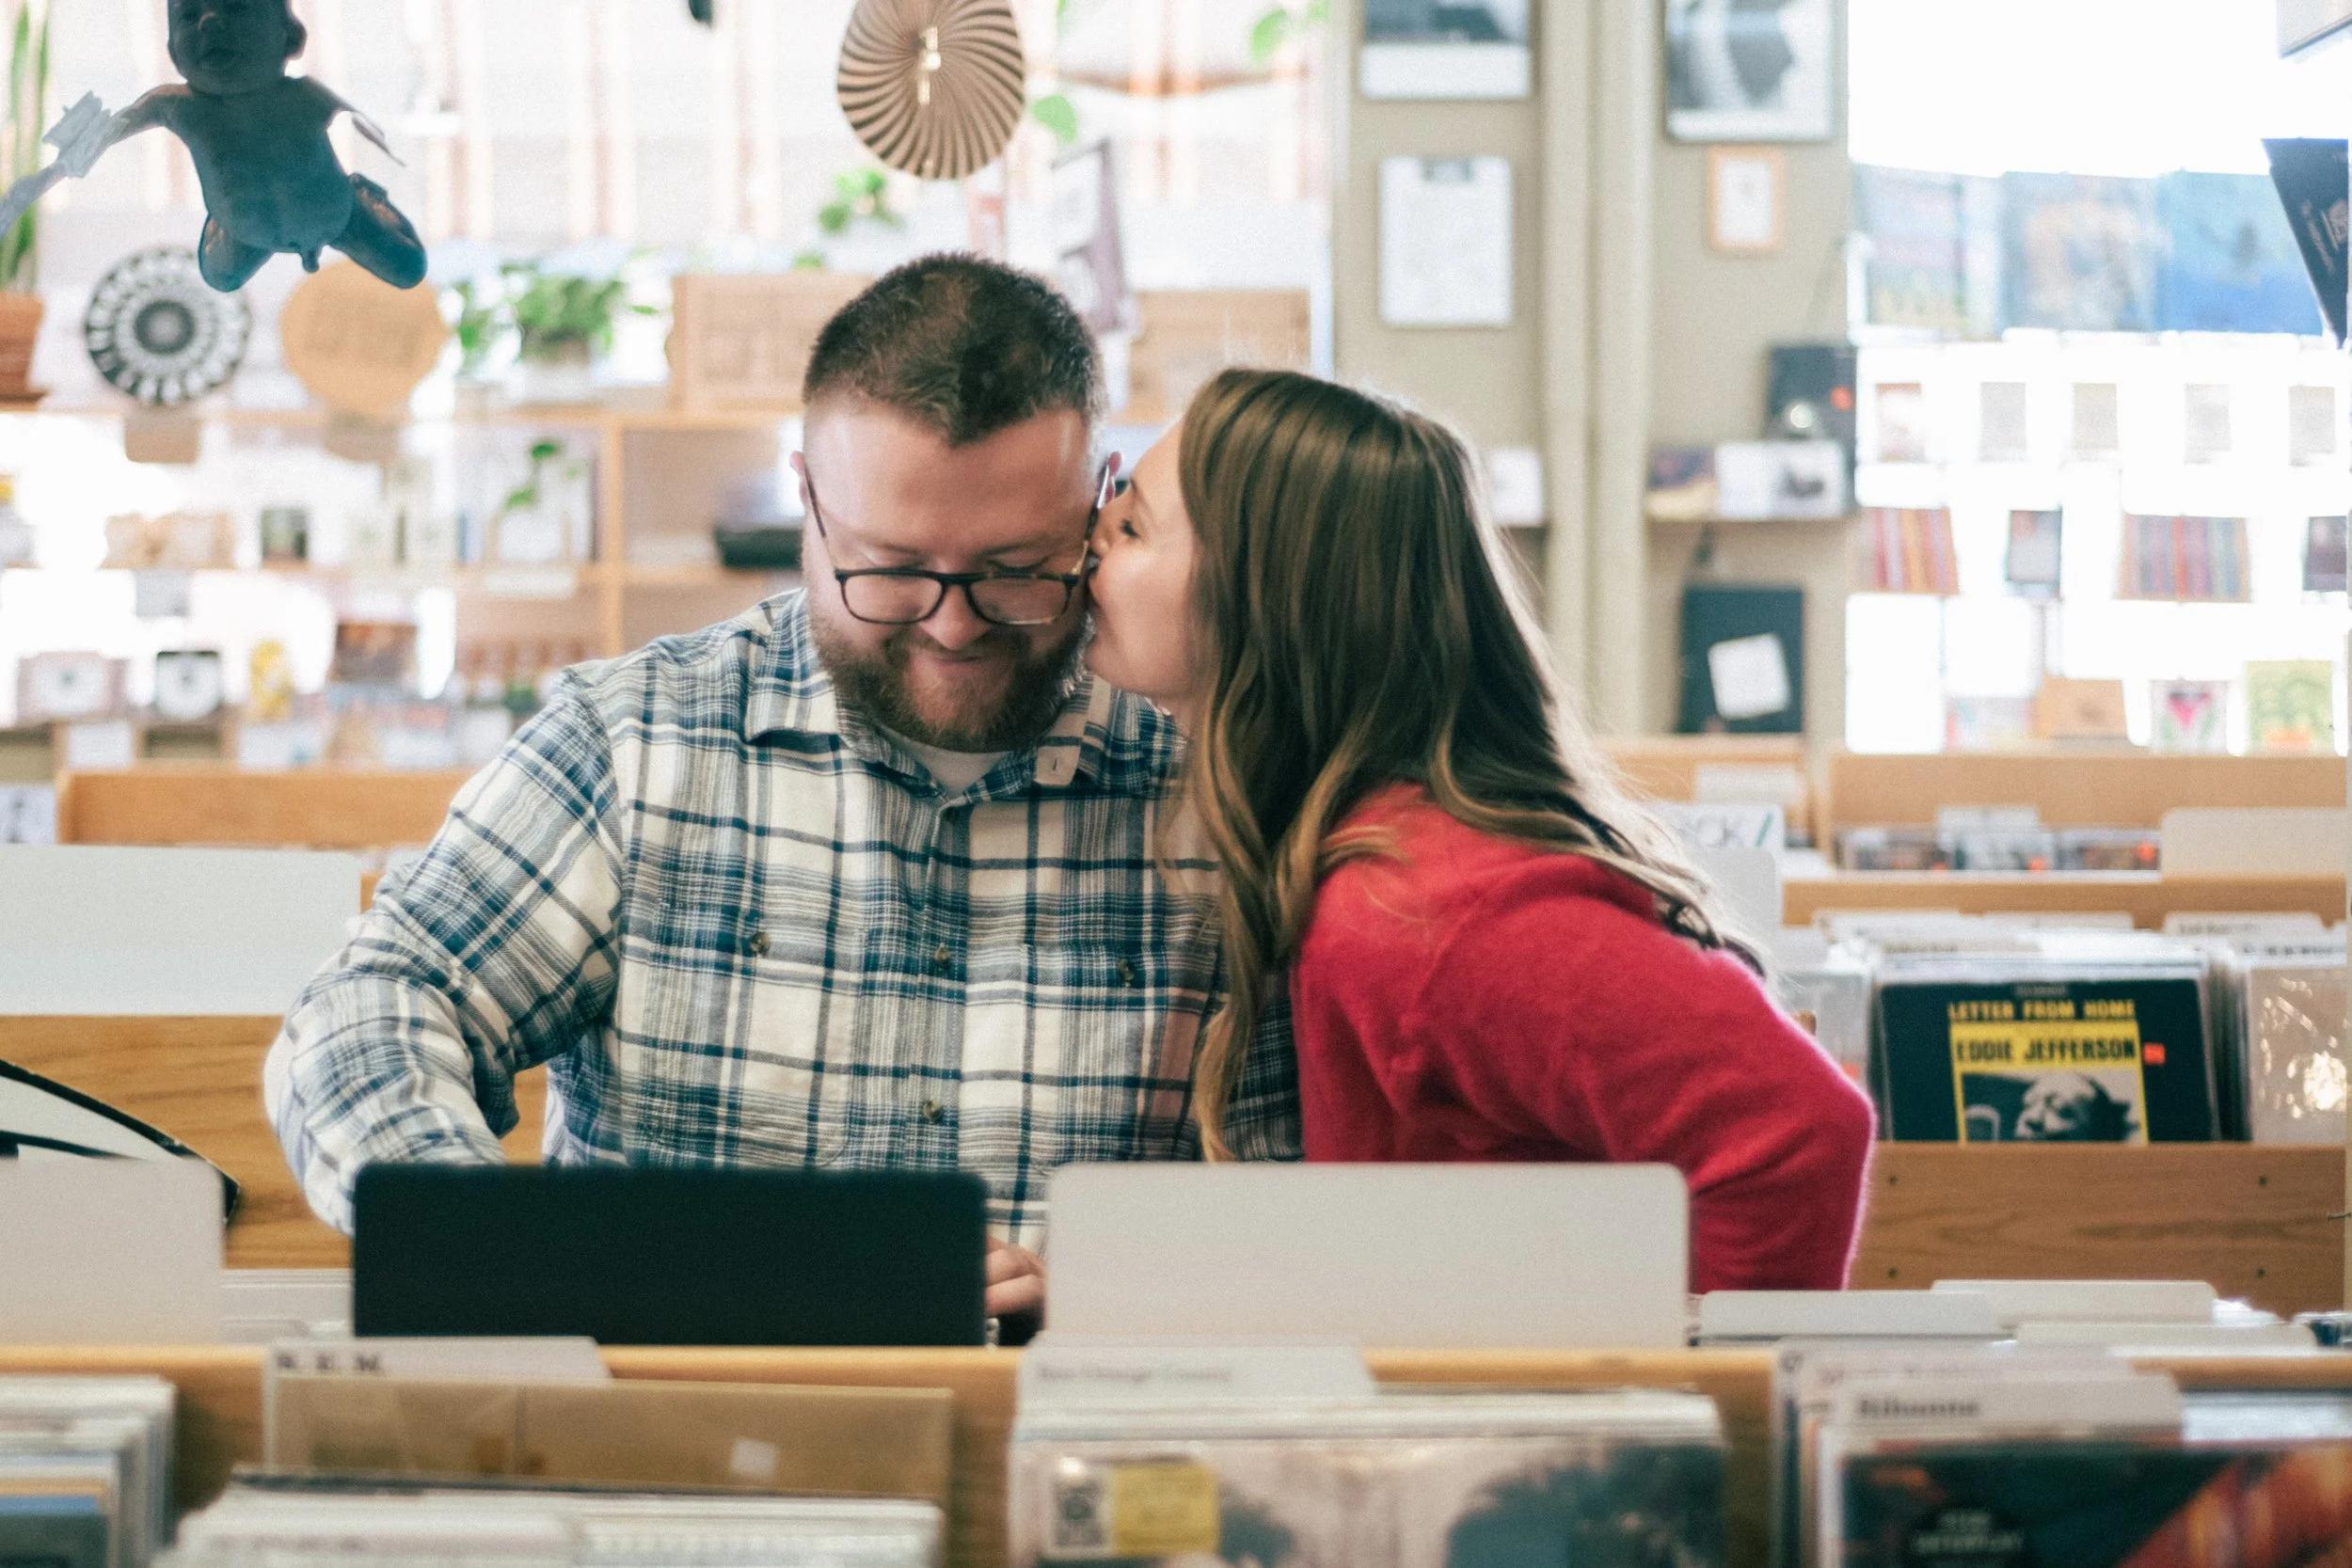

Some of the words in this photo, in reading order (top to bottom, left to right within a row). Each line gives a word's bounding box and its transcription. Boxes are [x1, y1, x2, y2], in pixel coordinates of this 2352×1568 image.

[1948, 1001, 2013, 1019] LETTER
[2025, 1001, 2075, 1019] FROM
[2084, 1000, 2136, 1019] HOME
[1957, 1039, 2011, 1061] EDDIE
[2026, 1038, 2136, 1061] JEFFERSON
